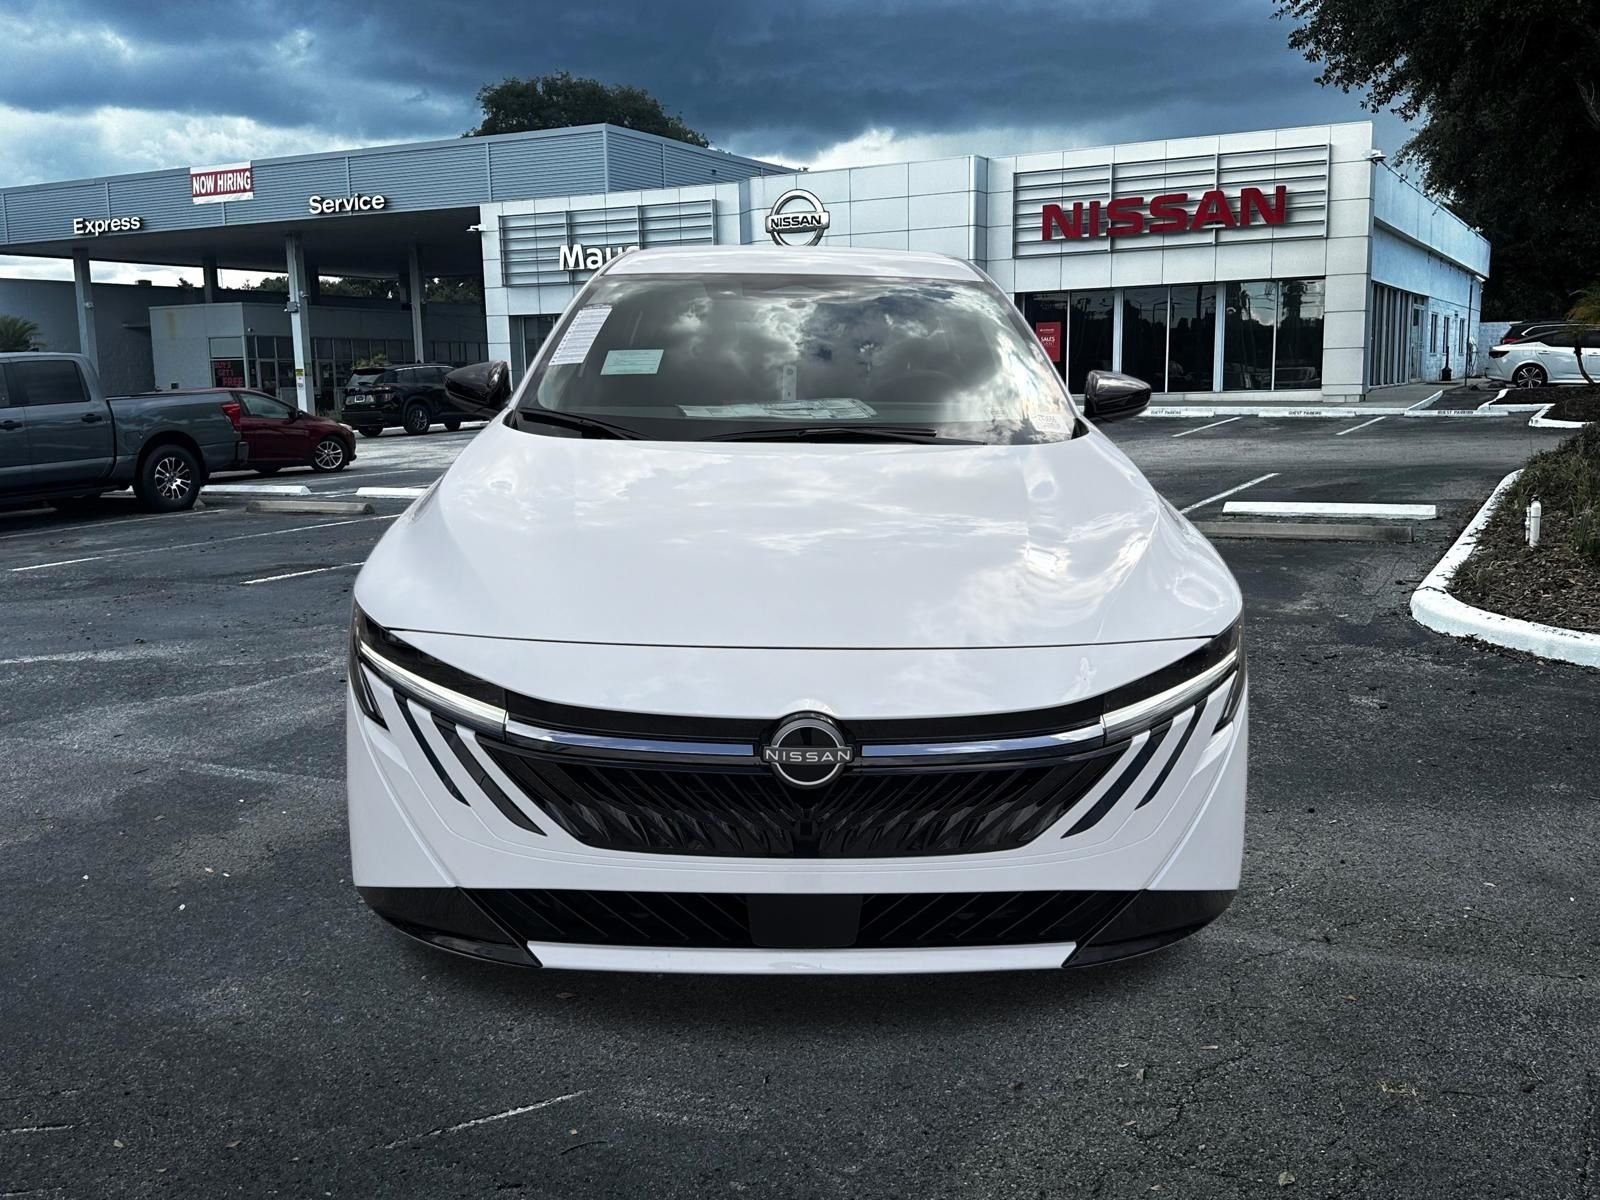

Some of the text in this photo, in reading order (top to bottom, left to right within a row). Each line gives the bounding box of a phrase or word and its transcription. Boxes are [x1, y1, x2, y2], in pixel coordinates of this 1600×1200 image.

[193, 171, 251, 195] NOW HIRING
[309, 193, 385, 214] Service
[1041, 185, 1287, 241] NISSAN
[73, 216, 141, 237] Express
[770, 215, 822, 228] NISSAN
[765, 749, 851, 762] NISSAN
